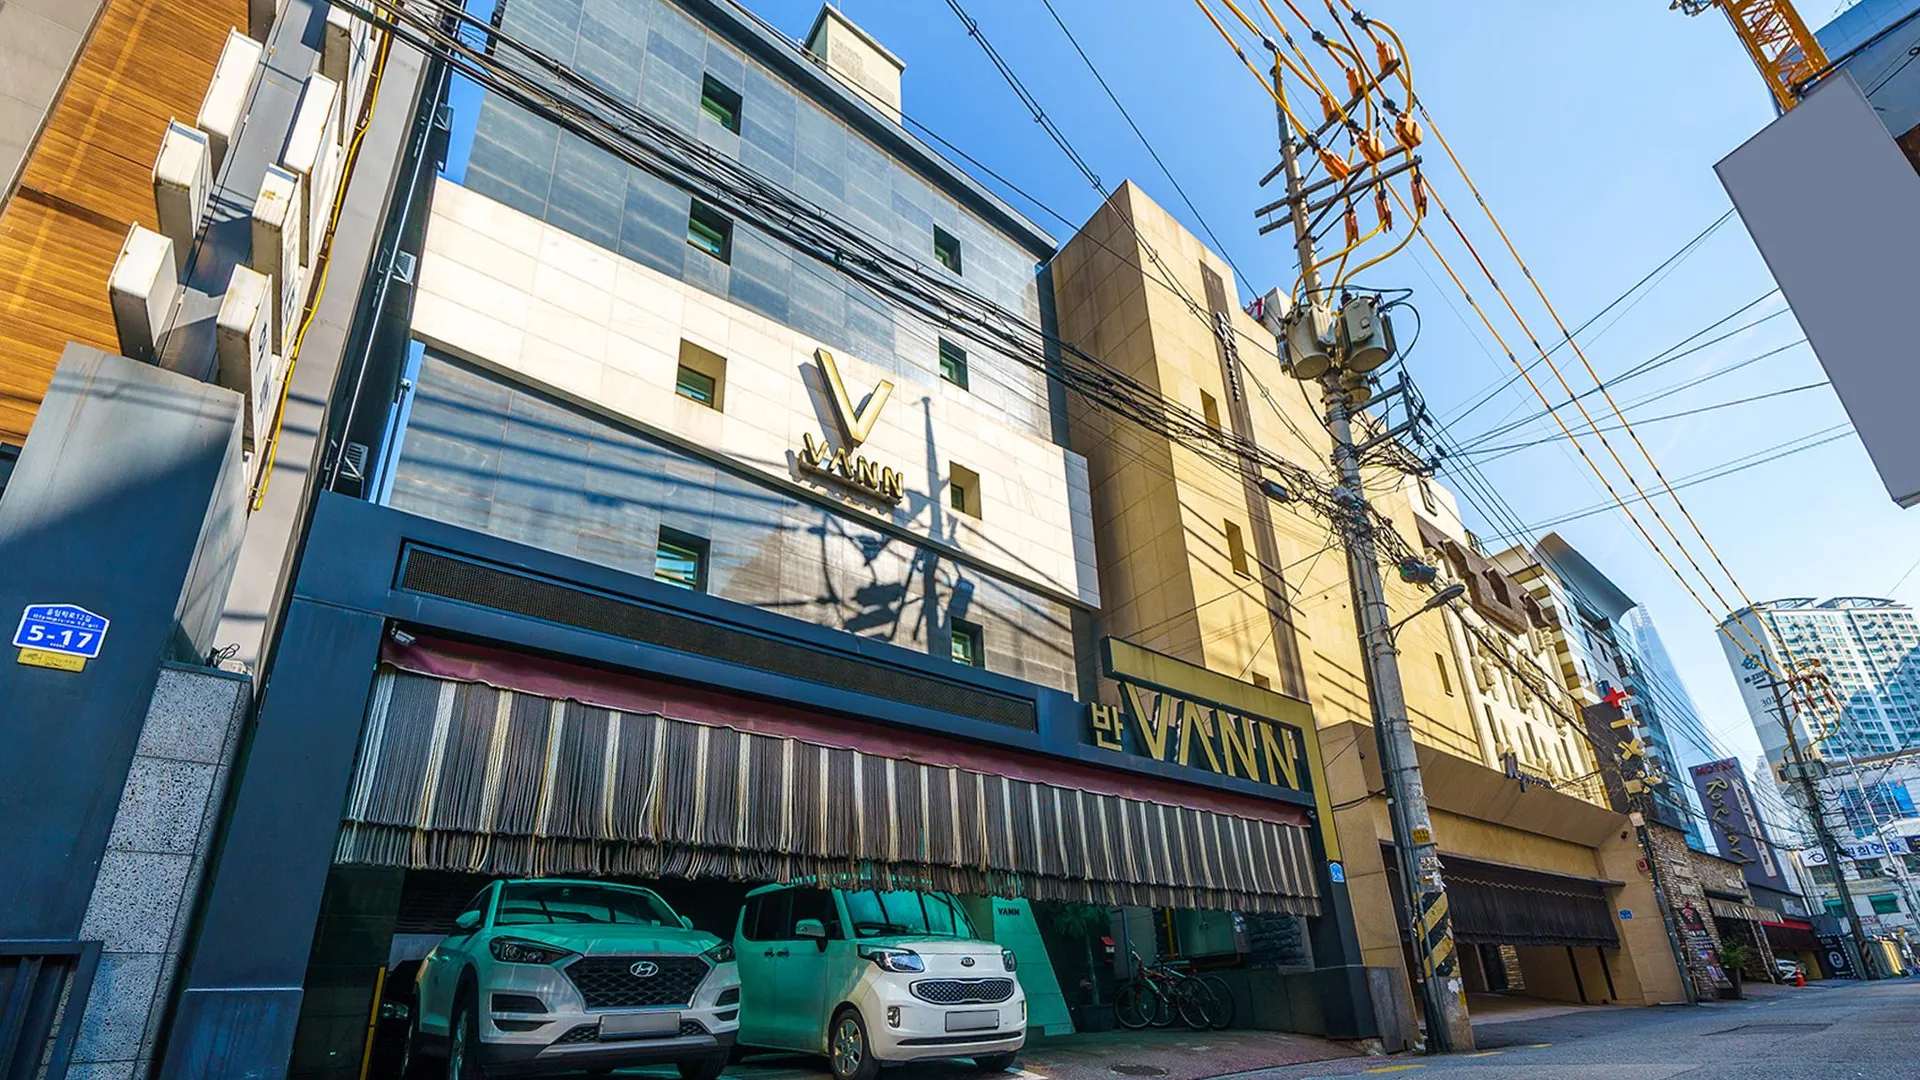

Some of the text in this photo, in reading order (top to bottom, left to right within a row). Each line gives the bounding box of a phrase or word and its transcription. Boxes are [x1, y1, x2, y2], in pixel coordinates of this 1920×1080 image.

[803, 433, 903, 498] VANN
[27, 625, 93, 648] 5-17
[1091, 681, 1300, 790] 반 VANN
[998, 907, 1020, 916] VANN
